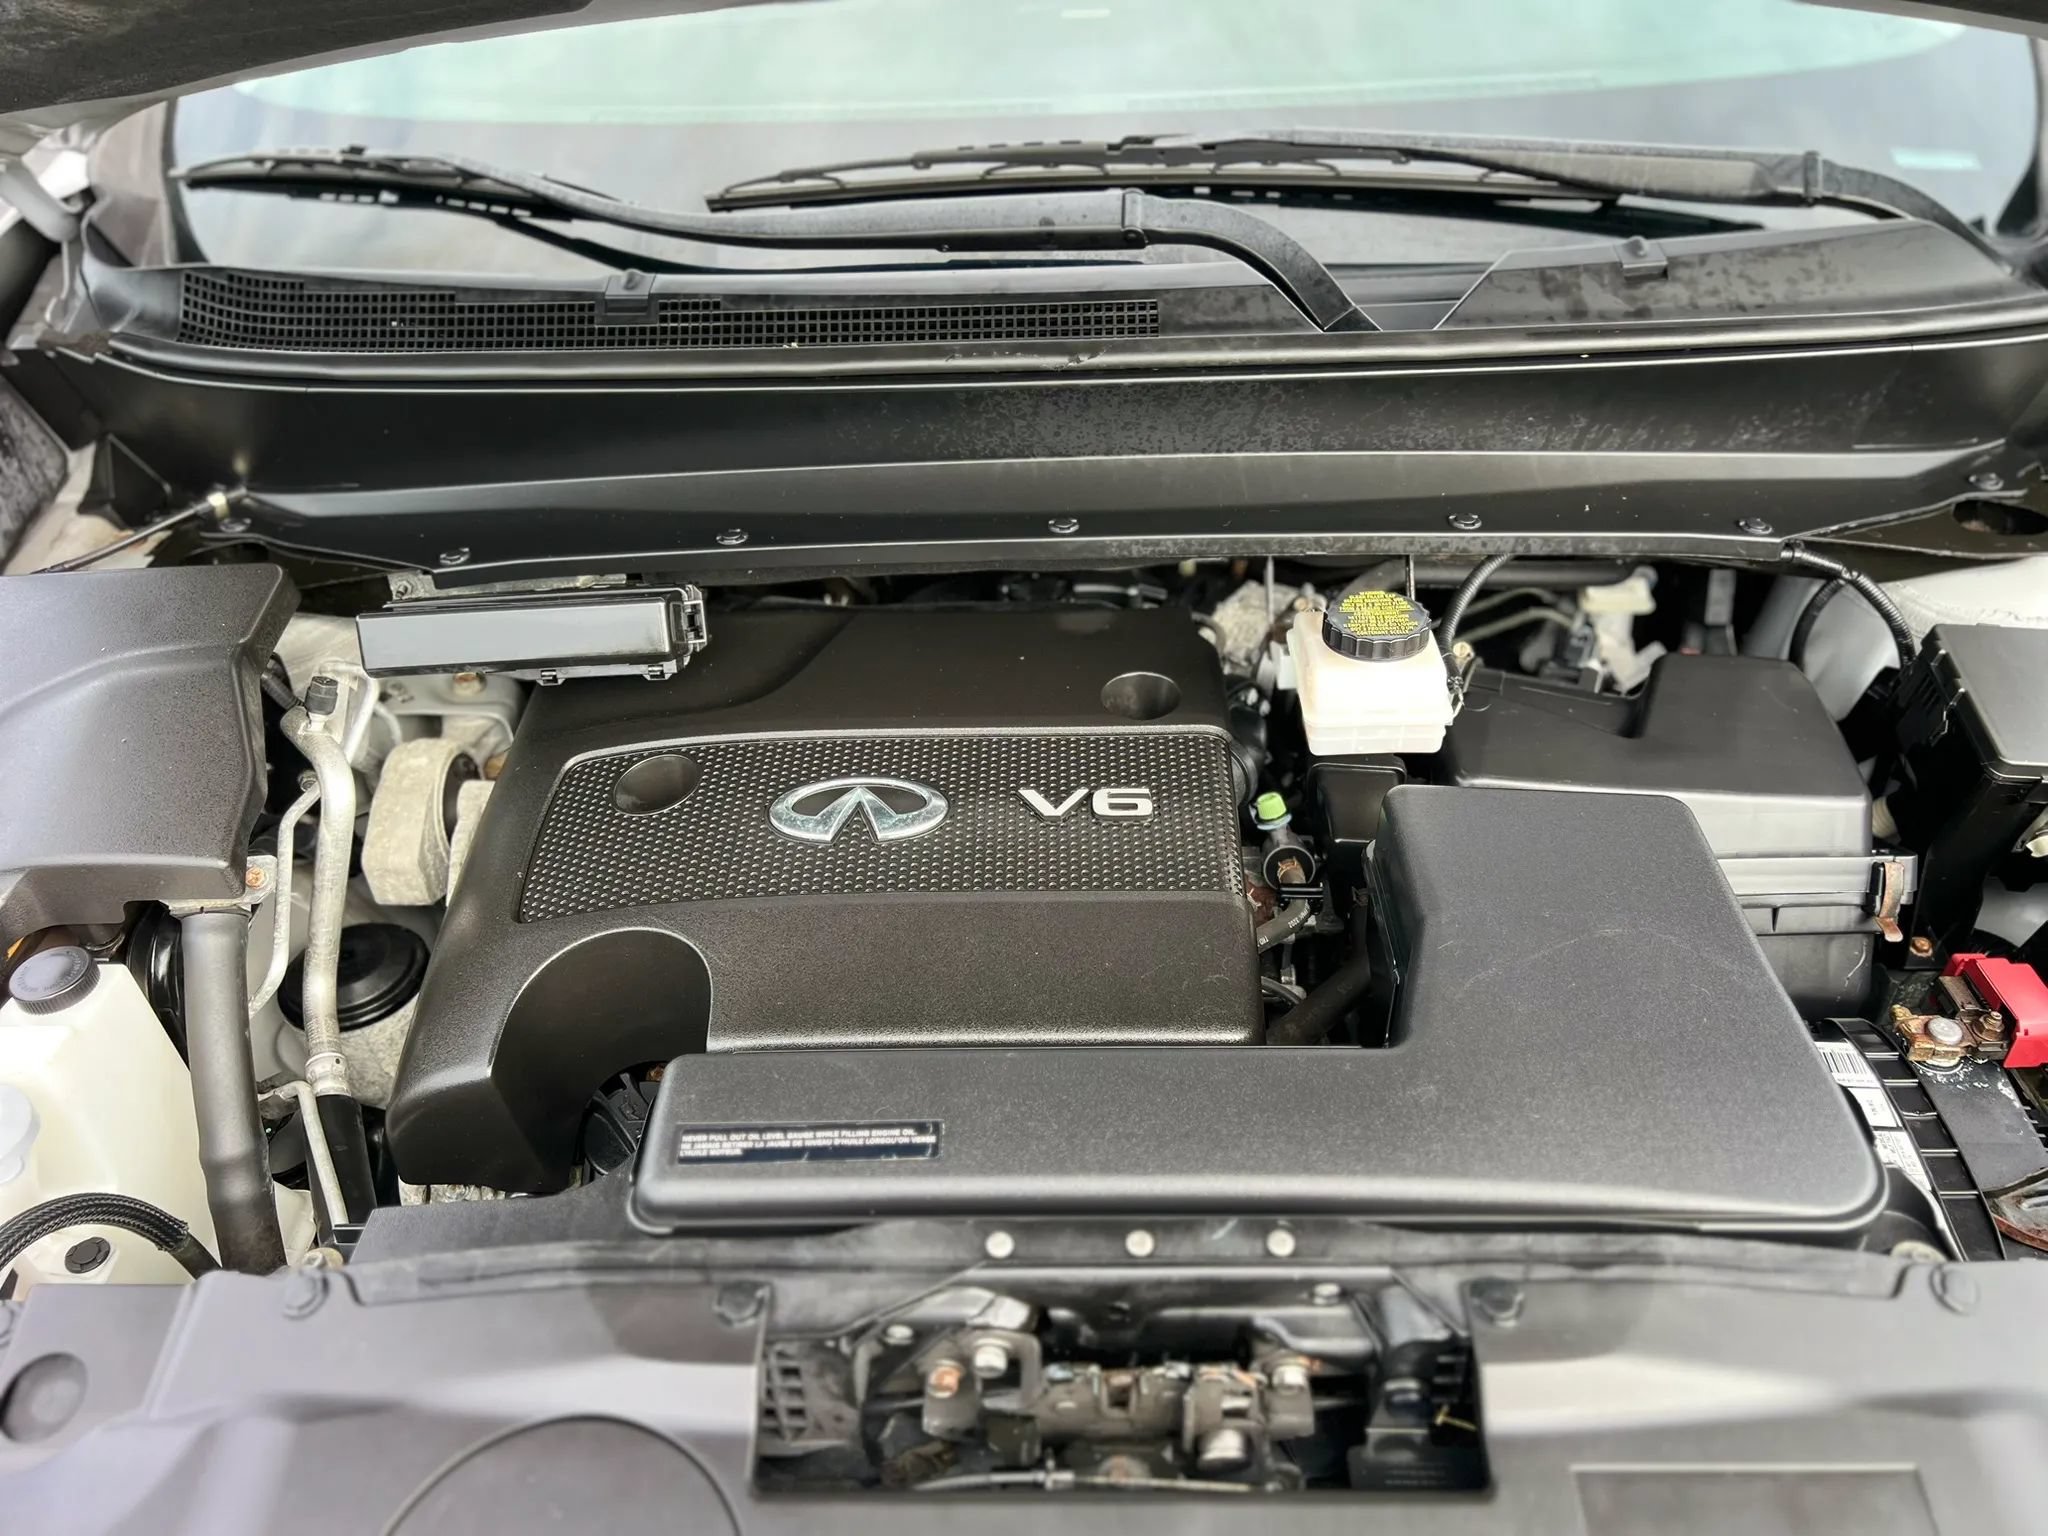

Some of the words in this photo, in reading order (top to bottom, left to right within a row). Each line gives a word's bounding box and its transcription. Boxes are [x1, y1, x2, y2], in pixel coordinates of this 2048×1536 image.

[1017, 788, 1153, 818] V6
[708, 1133, 728, 1141] PULL
[729, 1133, 746, 1141] OUT
[747, 1132, 761, 1140] OIL
[762, 1132, 785, 1140] LEVEL
[787, 1131, 814, 1139] GAUGE
[815, 1130, 840, 1138] WHILE
[841, 1129, 870, 1137] FILLING
[871, 1128, 901, 1137] ENGINE
[754, 1140, 765, 1148] LA
[792, 1139, 803, 1147] DE
